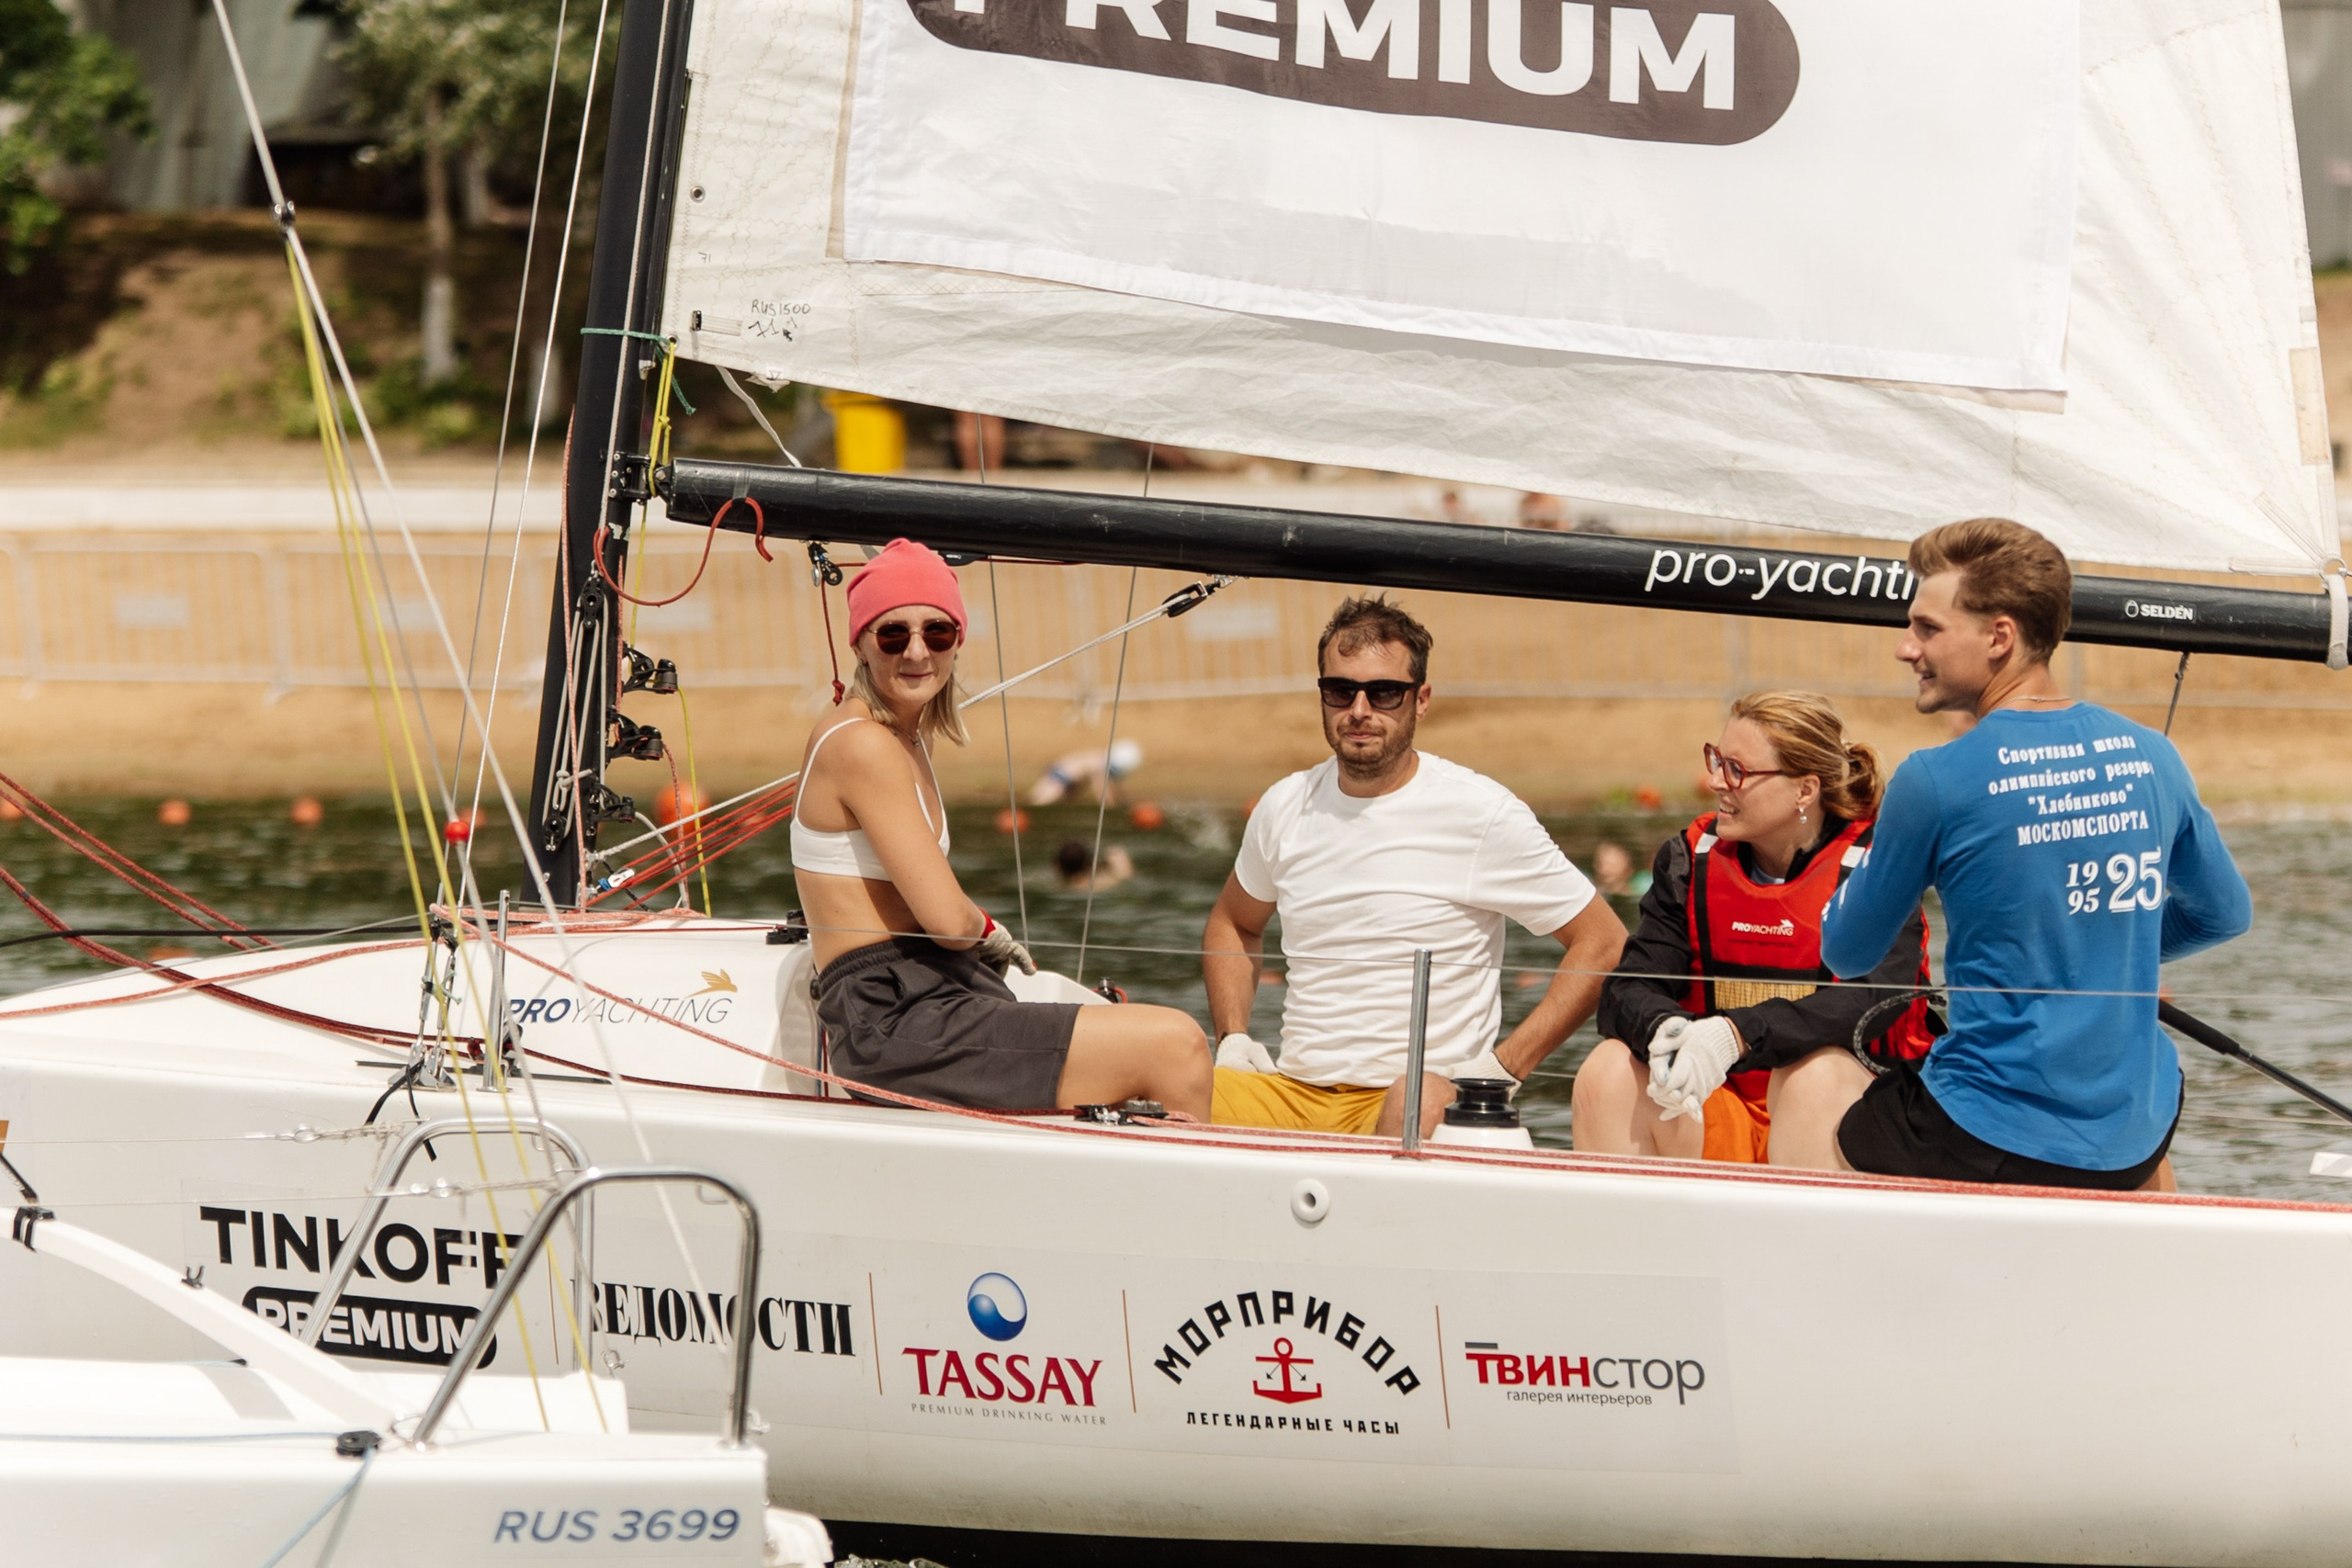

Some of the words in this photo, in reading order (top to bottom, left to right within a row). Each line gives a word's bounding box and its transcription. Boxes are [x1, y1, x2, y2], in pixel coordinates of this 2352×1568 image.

[1998, 743, 2086, 765] Спортивная
[1988, 767, 2097, 795] олимпийского
[2028, 783, 2133, 816] "Хлебниково"
[2018, 810, 2149, 846] МОСКОМСПОРТА
[2106, 845, 2163, 913] 25
[1731, 921, 1794, 936] PROYACHTING
[507, 998, 733, 1024] PROYACHTING
[1154, 1290, 1421, 1396] МОРПРИБОР
[901, 1347, 1104, 1407] TASSAY
[1507, 1391, 1563, 1404] галерея
[1567, 1393, 1652, 1407] интерьеров
[911, 1403, 974, 1416] PREMIUM
[982, 1407, 1053, 1422] DRINKING
[1061, 1413, 1107, 1426] WATER
[1187, 1412, 1333, 1431] ЛЕГЕНДАРНЫЕ
[1343, 1419, 1399, 1435] ЧАСЫ
[493, 1510, 599, 1543] RUS
[611, 1508, 741, 1543] 3699
